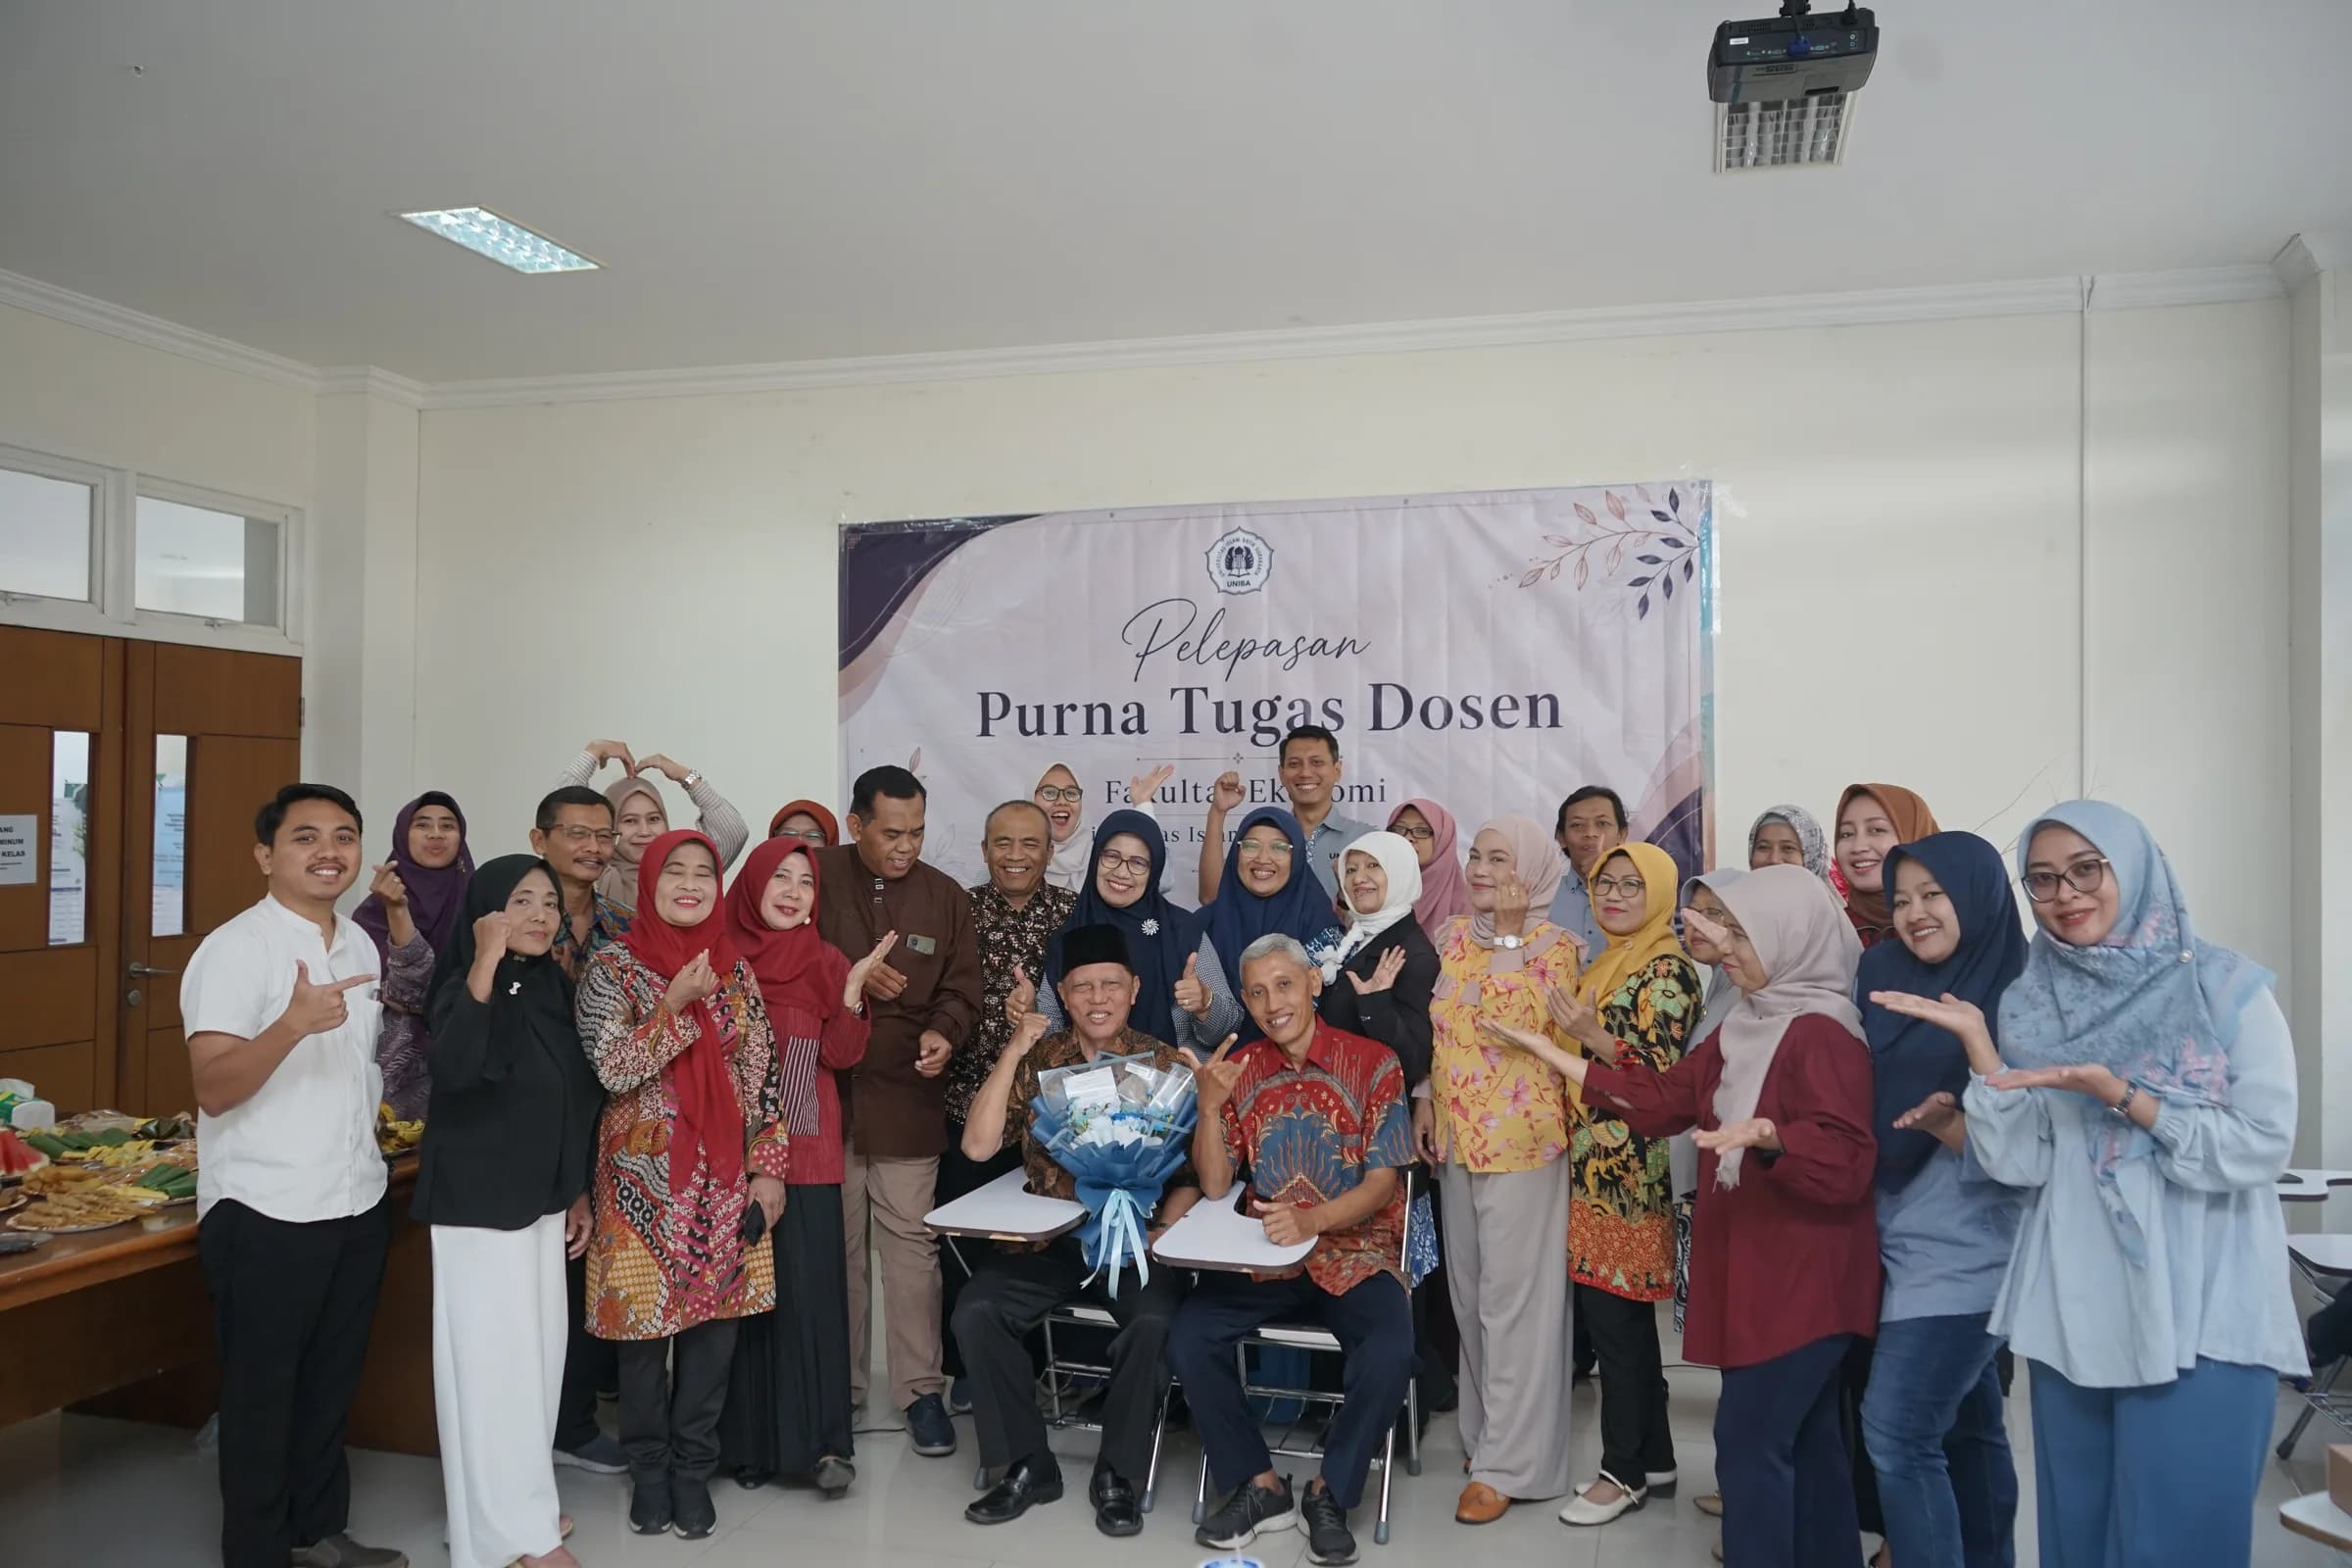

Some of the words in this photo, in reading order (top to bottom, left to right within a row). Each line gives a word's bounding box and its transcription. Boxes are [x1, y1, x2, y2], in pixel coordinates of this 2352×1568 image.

[1122, 598, 1371, 682] Pelepasan
[976, 691, 1150, 737] Purna
[1170, 687, 1345, 748] Tugas
[1367, 683, 1563, 731] Dosen
[1105, 779, 1216, 804] Faulta
[1249, 778, 1386, 804] Ekomi
